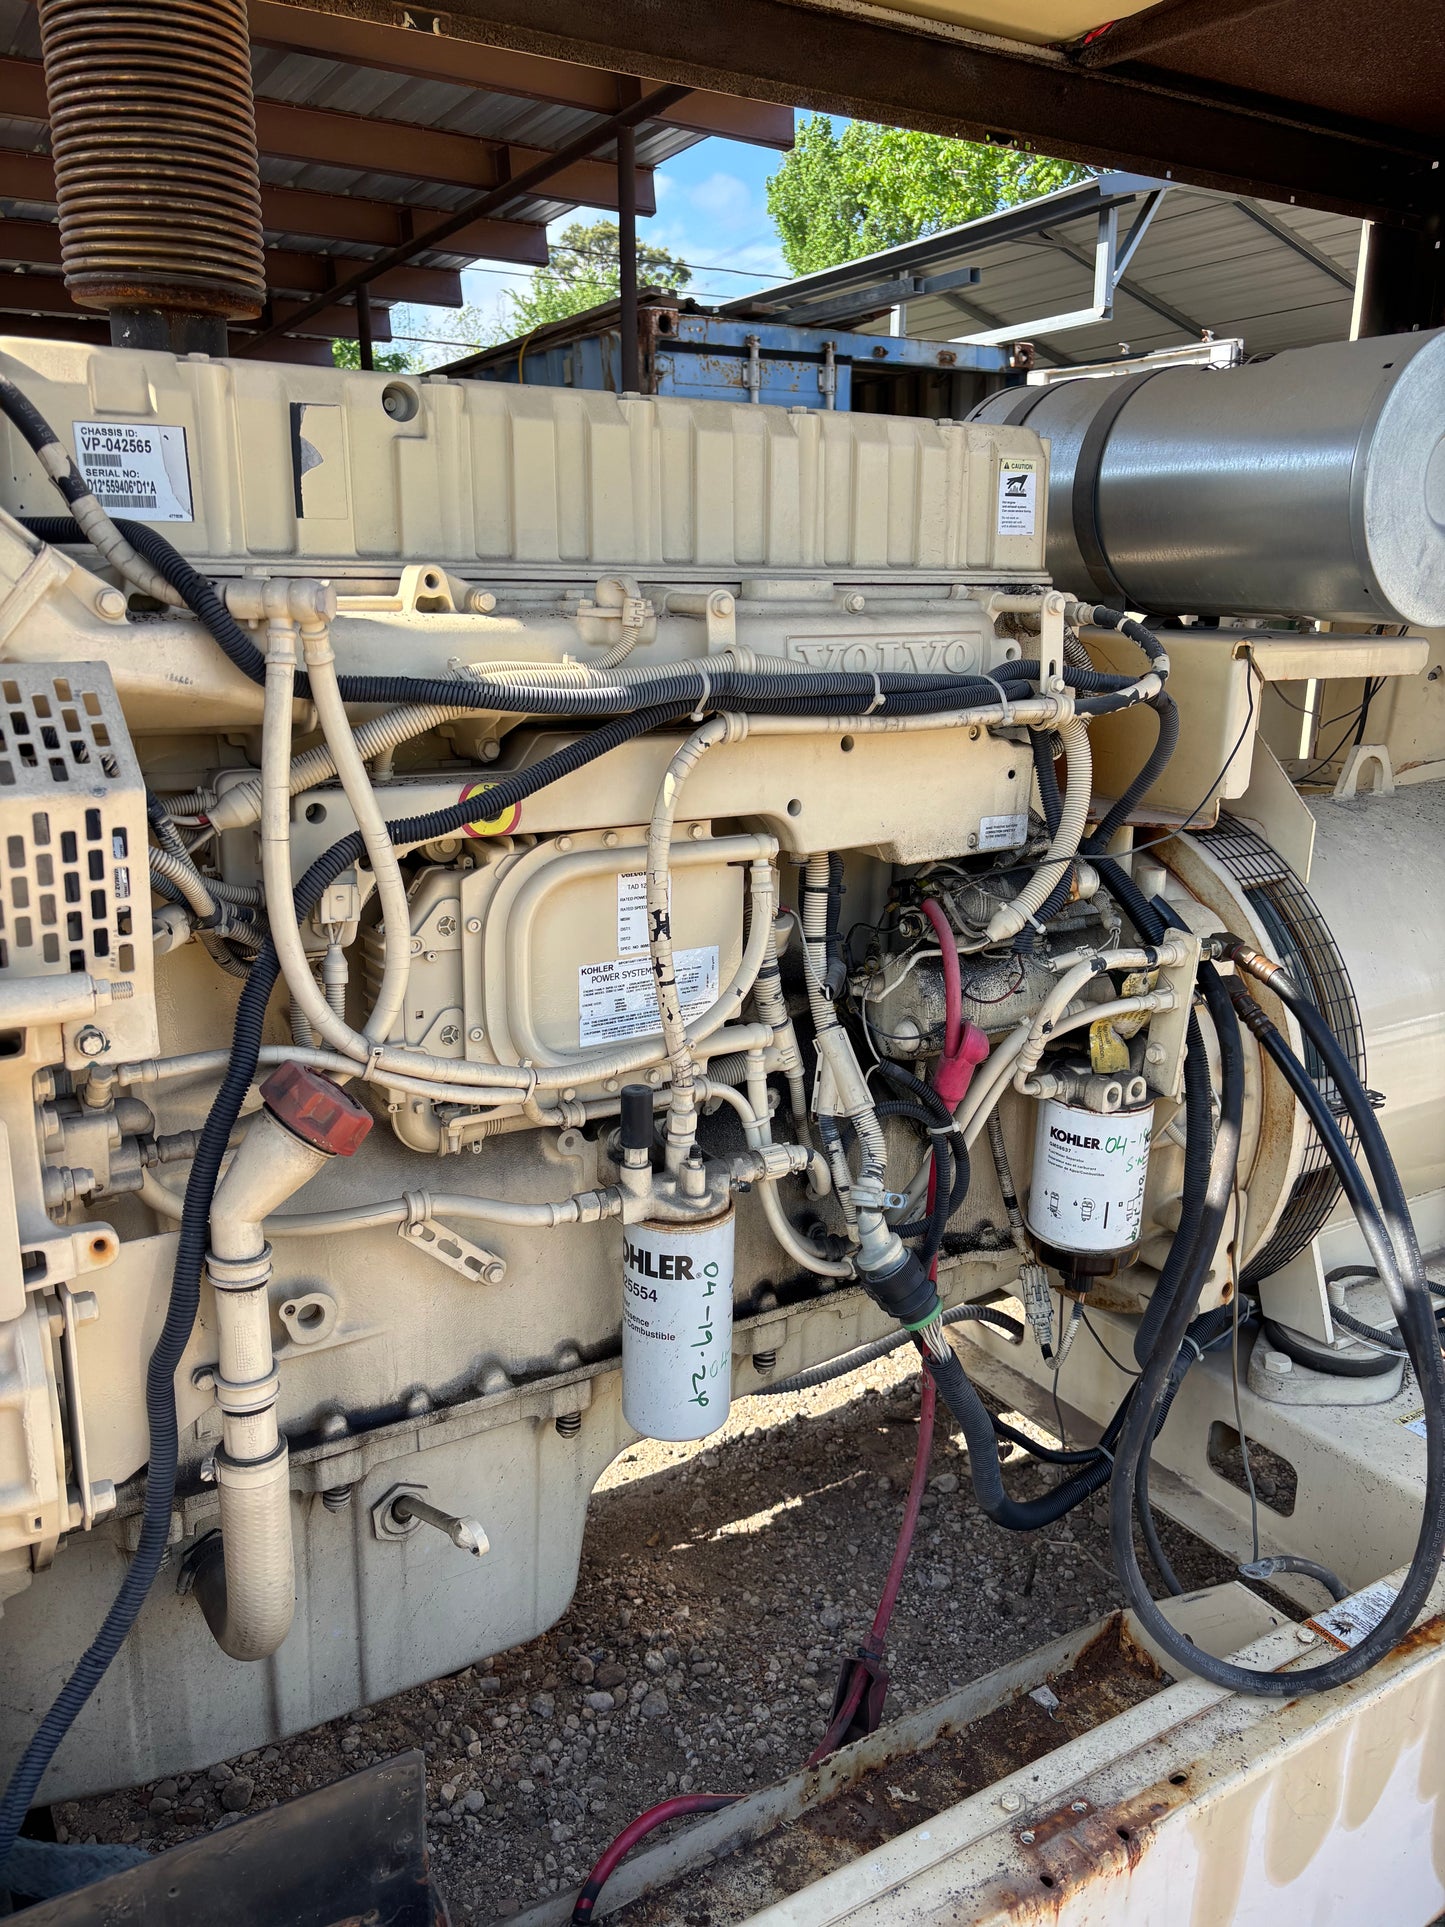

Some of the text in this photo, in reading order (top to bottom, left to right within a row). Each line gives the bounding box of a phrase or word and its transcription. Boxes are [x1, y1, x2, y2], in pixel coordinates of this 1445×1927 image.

[81, 427, 138, 437] CHASSIS ID:
[81, 437, 152, 453] VP-042565
[85, 468, 140, 478] SERIAL NO:
[797, 640, 976, 674] VOLVO
[581, 964, 614, 976] KOHLER
[591, 967, 654, 984] POWER SYSTEM
[1050, 1125, 1100, 1151] KOHLER
[622, 1235, 695, 1281] OHLER
[624, 1274, 658, 1303] 25554
[628, 1318, 676, 1341] Combustible
